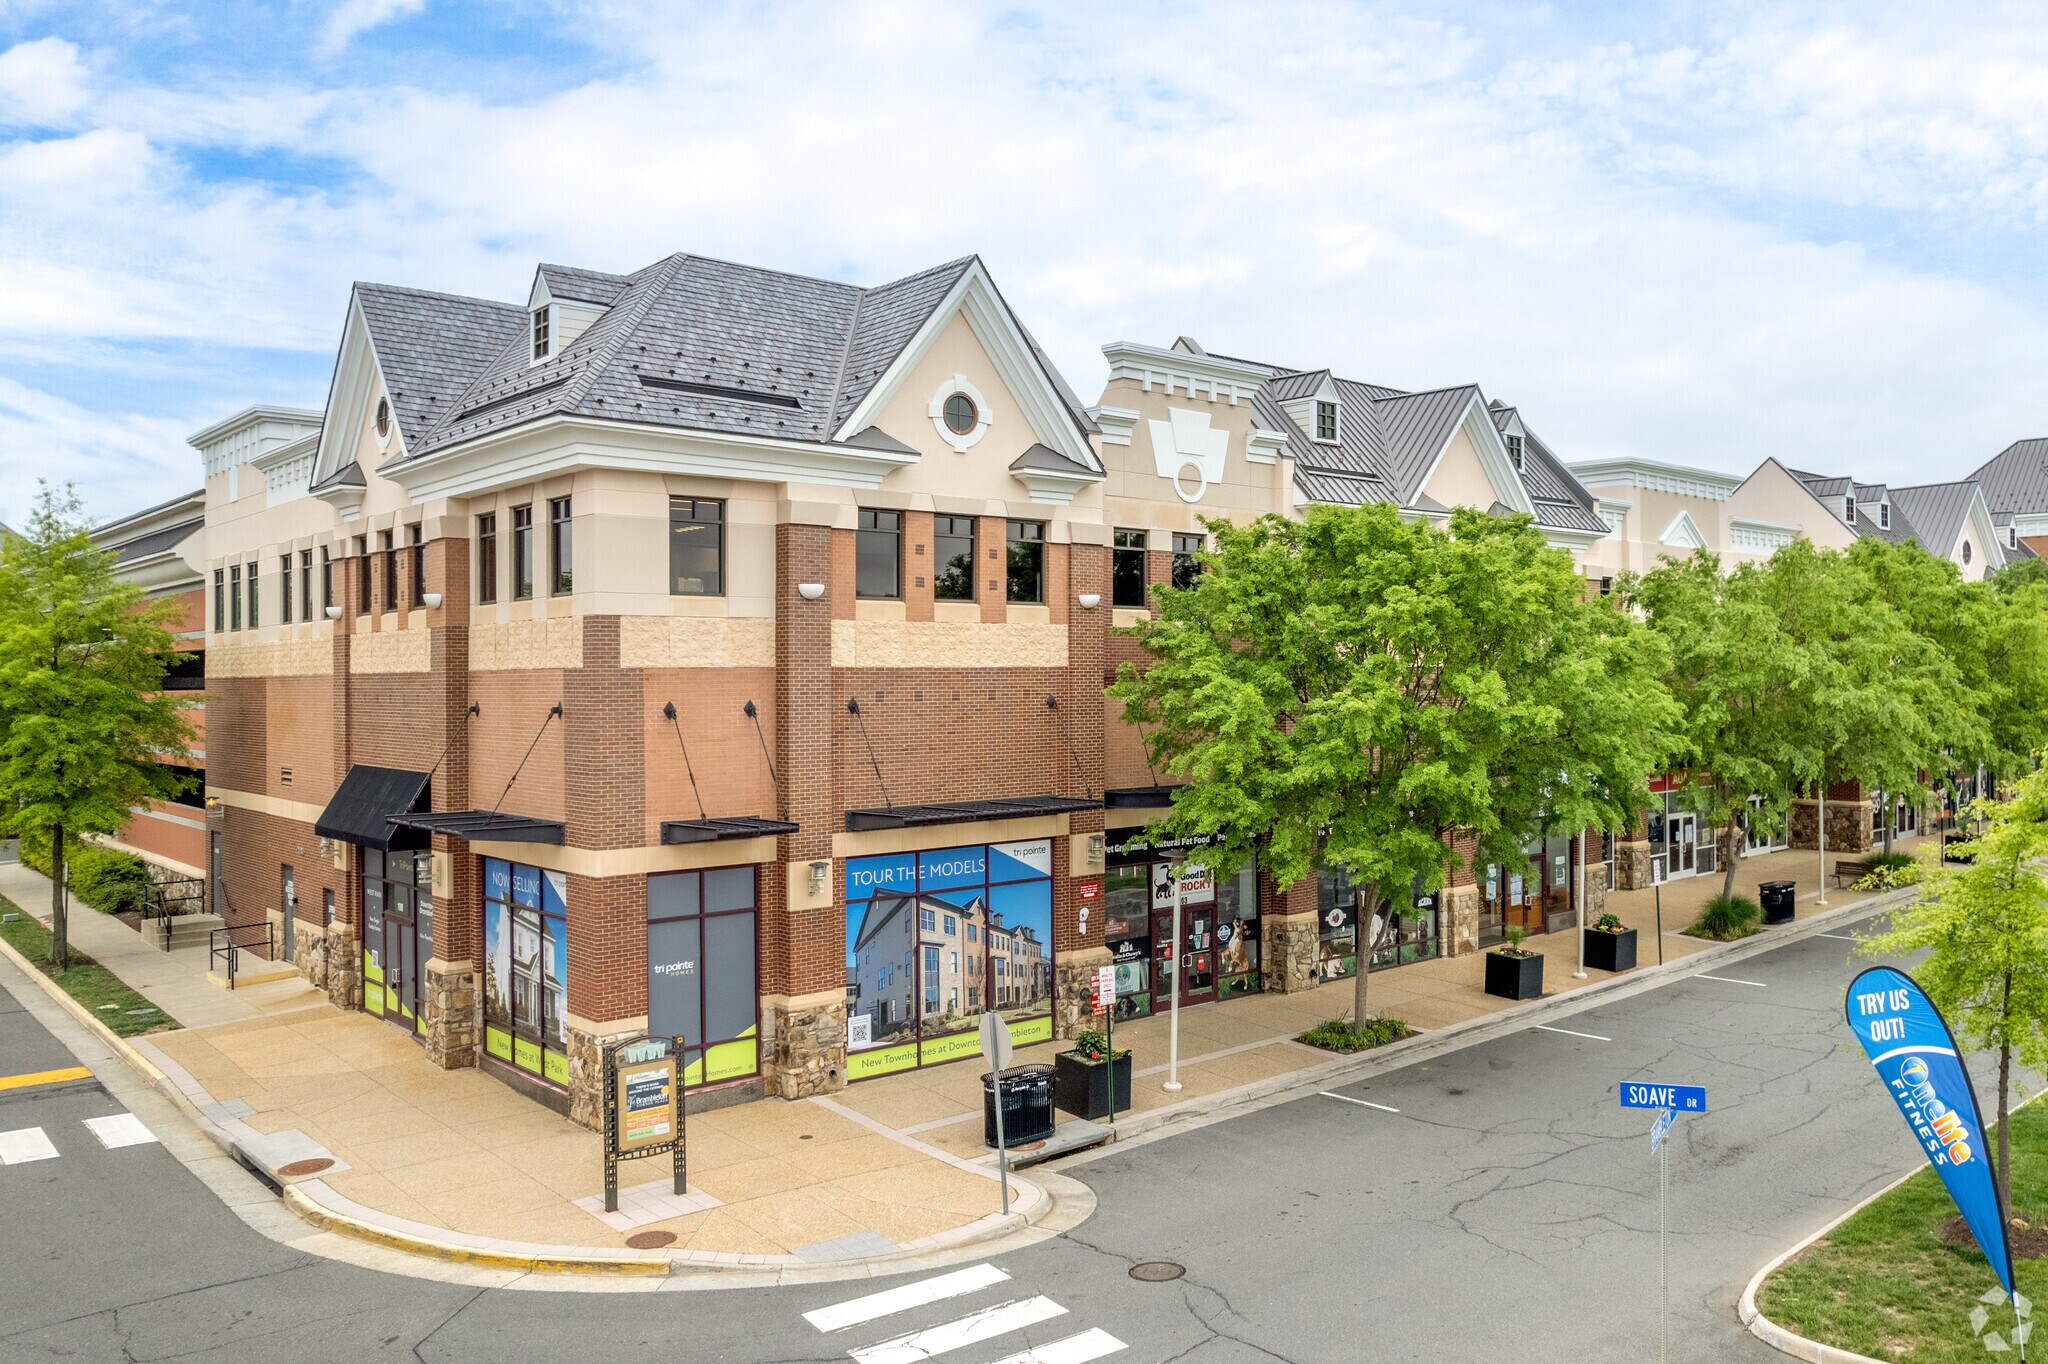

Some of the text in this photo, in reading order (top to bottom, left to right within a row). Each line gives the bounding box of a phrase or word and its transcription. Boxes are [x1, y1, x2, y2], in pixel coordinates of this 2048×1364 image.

[1114, 842, 1148, 853] Grming
[1181, 837, 1193, 846] Pet
[1193, 835, 1211, 845] Food
[1022, 846, 1047, 859] pointe
[492, 872, 510, 888] NOW
[852, 859, 986, 887] TOUR THE MODELS
[654, 960, 695, 975] tri pointe
[670, 969, 694, 977] HOMES
[1856, 988, 1910, 1016] TRY US
[1870, 1017, 1906, 1043] OUT!
[497, 1037, 509, 1051] New
[514, 1047, 528, 1061] omes
[551, 1060, 563, 1074] Park
[861, 1025, 1041, 1069] New Townhomes at Downto mbleton
[1629, 1085, 1698, 1108] SOAVE DR
[1891, 1078, 1949, 1166] FITNESS
